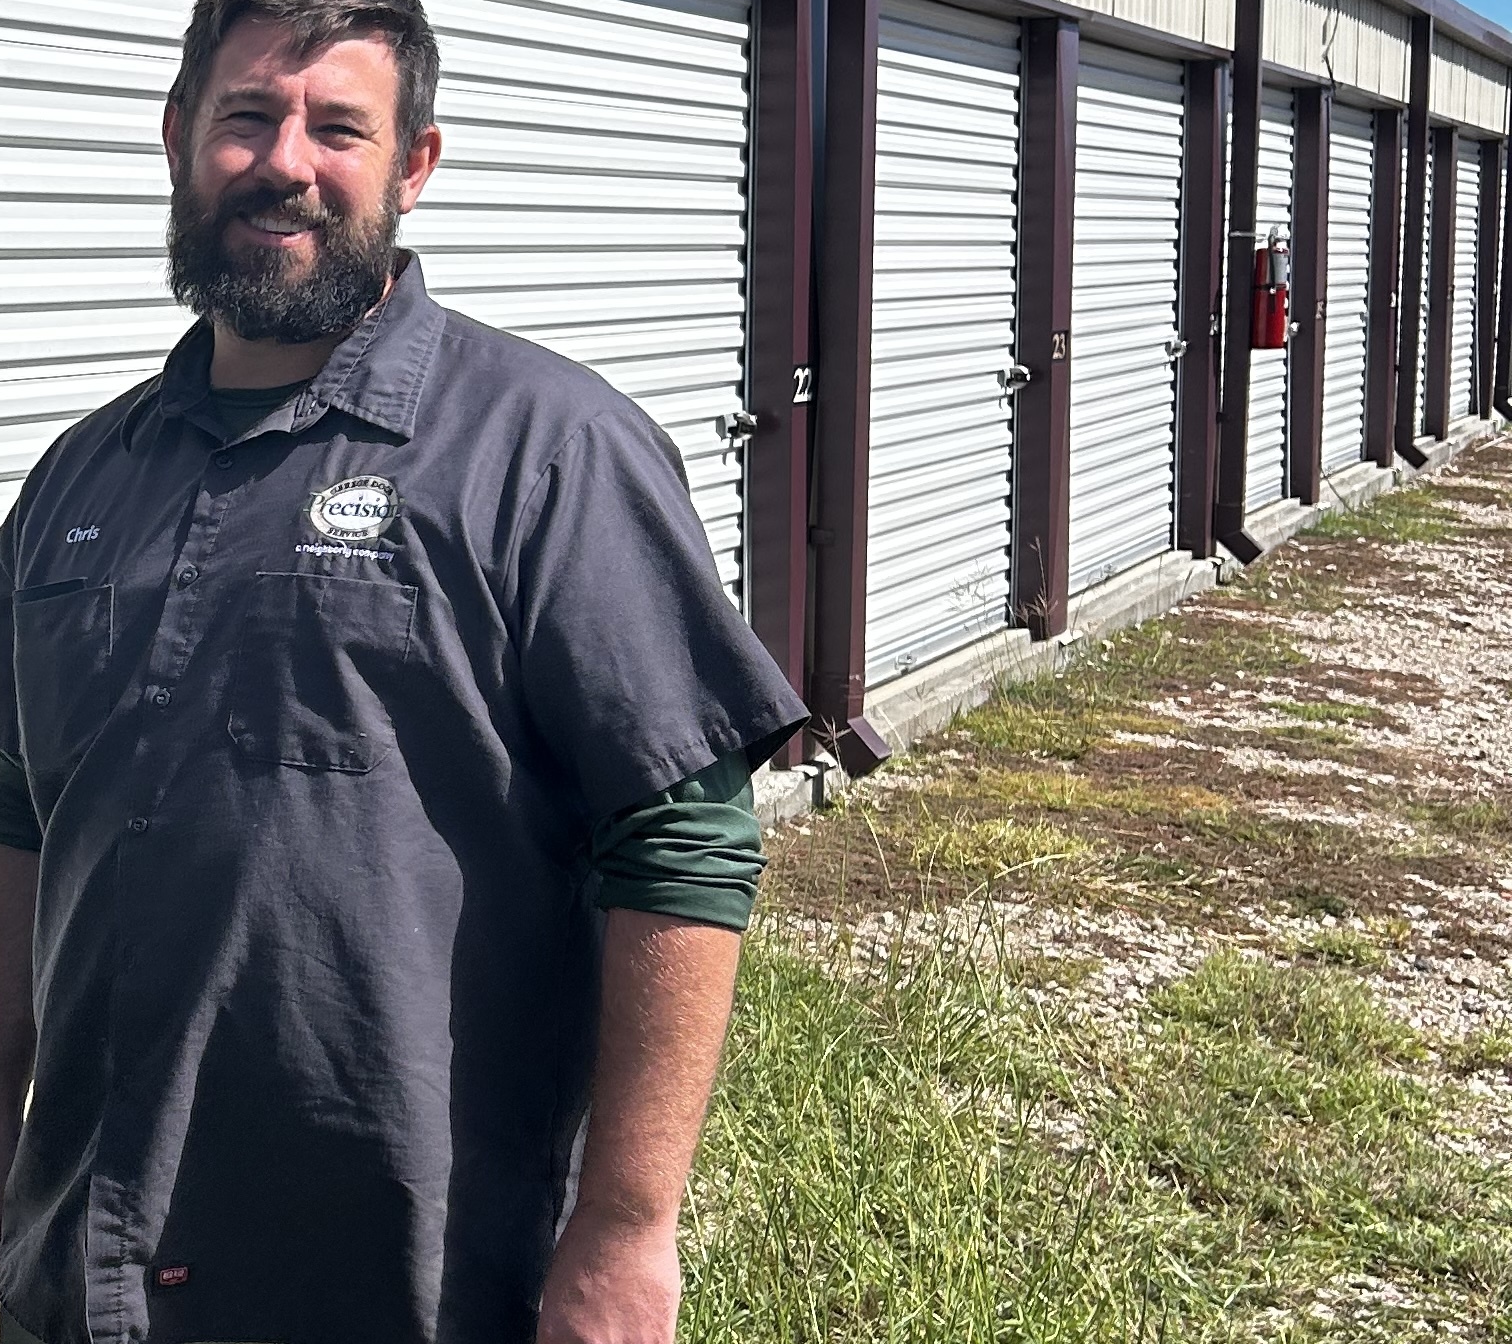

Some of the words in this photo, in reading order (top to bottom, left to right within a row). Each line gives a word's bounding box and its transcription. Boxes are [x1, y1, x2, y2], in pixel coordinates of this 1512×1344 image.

[1052, 333, 1067, 360] 23
[792, 367, 813, 404] 22
[65, 523, 101, 545] Chris
